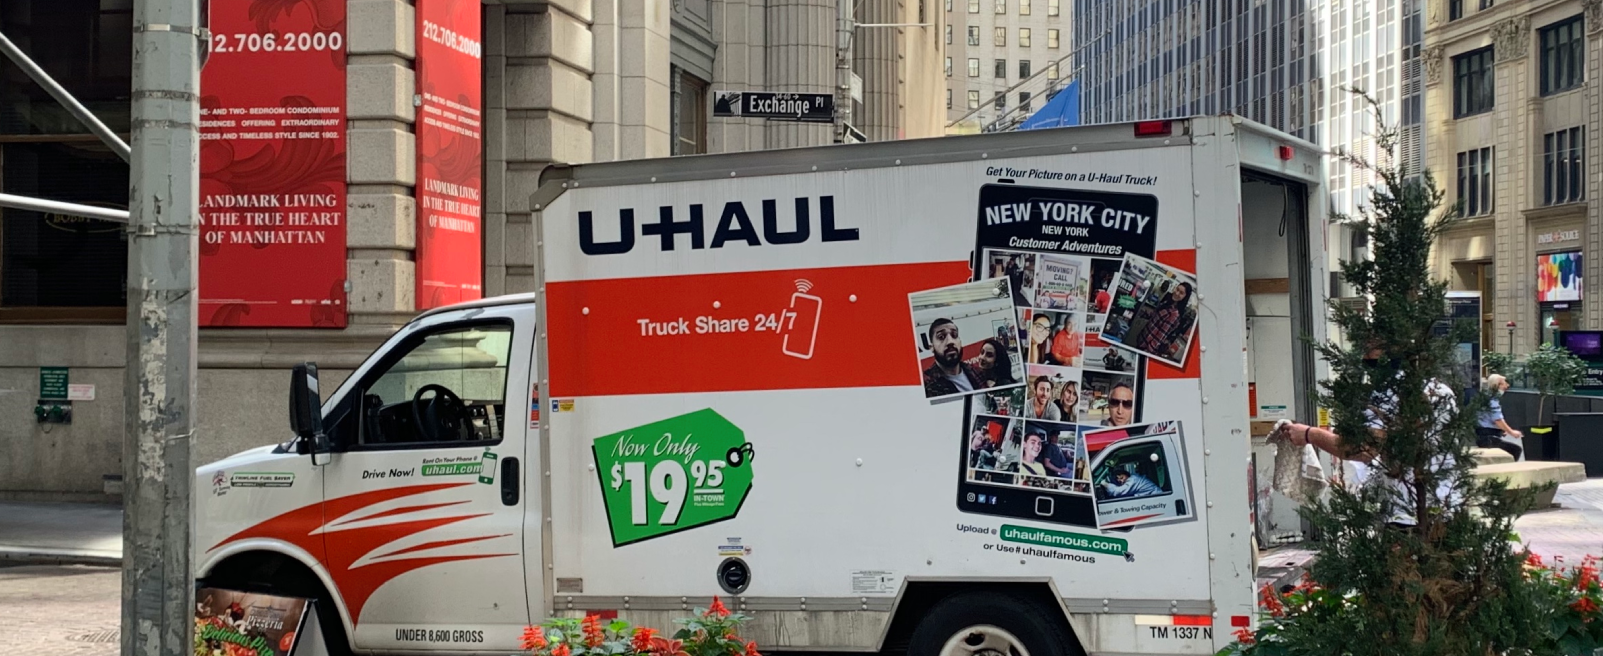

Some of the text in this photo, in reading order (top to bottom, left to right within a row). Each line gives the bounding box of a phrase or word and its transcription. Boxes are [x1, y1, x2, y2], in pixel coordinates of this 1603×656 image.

[208, 32, 342, 52] 12.706.2000
[423, 19, 481, 59] 212.706.2000
[287, 106, 340, 114] CONDOMINIUM
[749, 95, 824, 117] Exchange Pl
[241, 119, 276, 127] OFFERING
[281, 119, 340, 127] EXTRAORDINARY
[199, 132, 220, 140] CCESS
[986, 166, 1003, 176] Get
[1004, 168, 1027, 178] Your
[1028, 169, 1063, 180] Picture
[1065, 173, 1076, 181] on
[1087, 172, 1122, 183] U-Haul
[1124, 175, 1157, 186] Truck!
[424, 178, 479, 201] LANDMARK LIVING
[199, 194, 337, 208] ANDMARK LIVING
[423, 195, 480, 218] IN THE TRUE HEART
[210, 212, 240, 226] THE
[244, 212, 285, 226] TRUE
[288, 212, 342, 226] HEART
[429, 214, 475, 233] OF MANHATTAN
[578, 195, 859, 256] U-HAUL
[985, 202, 1150, 235] NEW YORK CITY
[205, 230, 325, 244] OF MANHATTAN
[1041, 225, 1090, 237] NEW YORK
[1009, 236, 1123, 255] Customer Adventures
[1046, 264, 1074, 275] MOVING?
[1053, 273, 1068, 282] CALL
[637, 308, 797, 336] Truck Share 24/7
[1588, 368, 1603, 376] Entry
[611, 432, 701, 464] Now Only
[362, 467, 415, 479] Drive Now!
[425, 463, 483, 475] uhaul.com
[693, 494, 725, 502] IN-TOWN
[1141, 502, 1167, 511] Capacity
[956, 523, 989, 534] Upload
[1004, 528, 1122, 552] uhaulfamous.com
[996, 543, 1014, 553] Use
[246, 615, 284, 631] Pizzeria
[202, 623, 251, 647] Delicious
[395, 628, 484, 643] UNDER 8,600 GROSS
[1149, 626, 1212, 640] TM 1337 N
